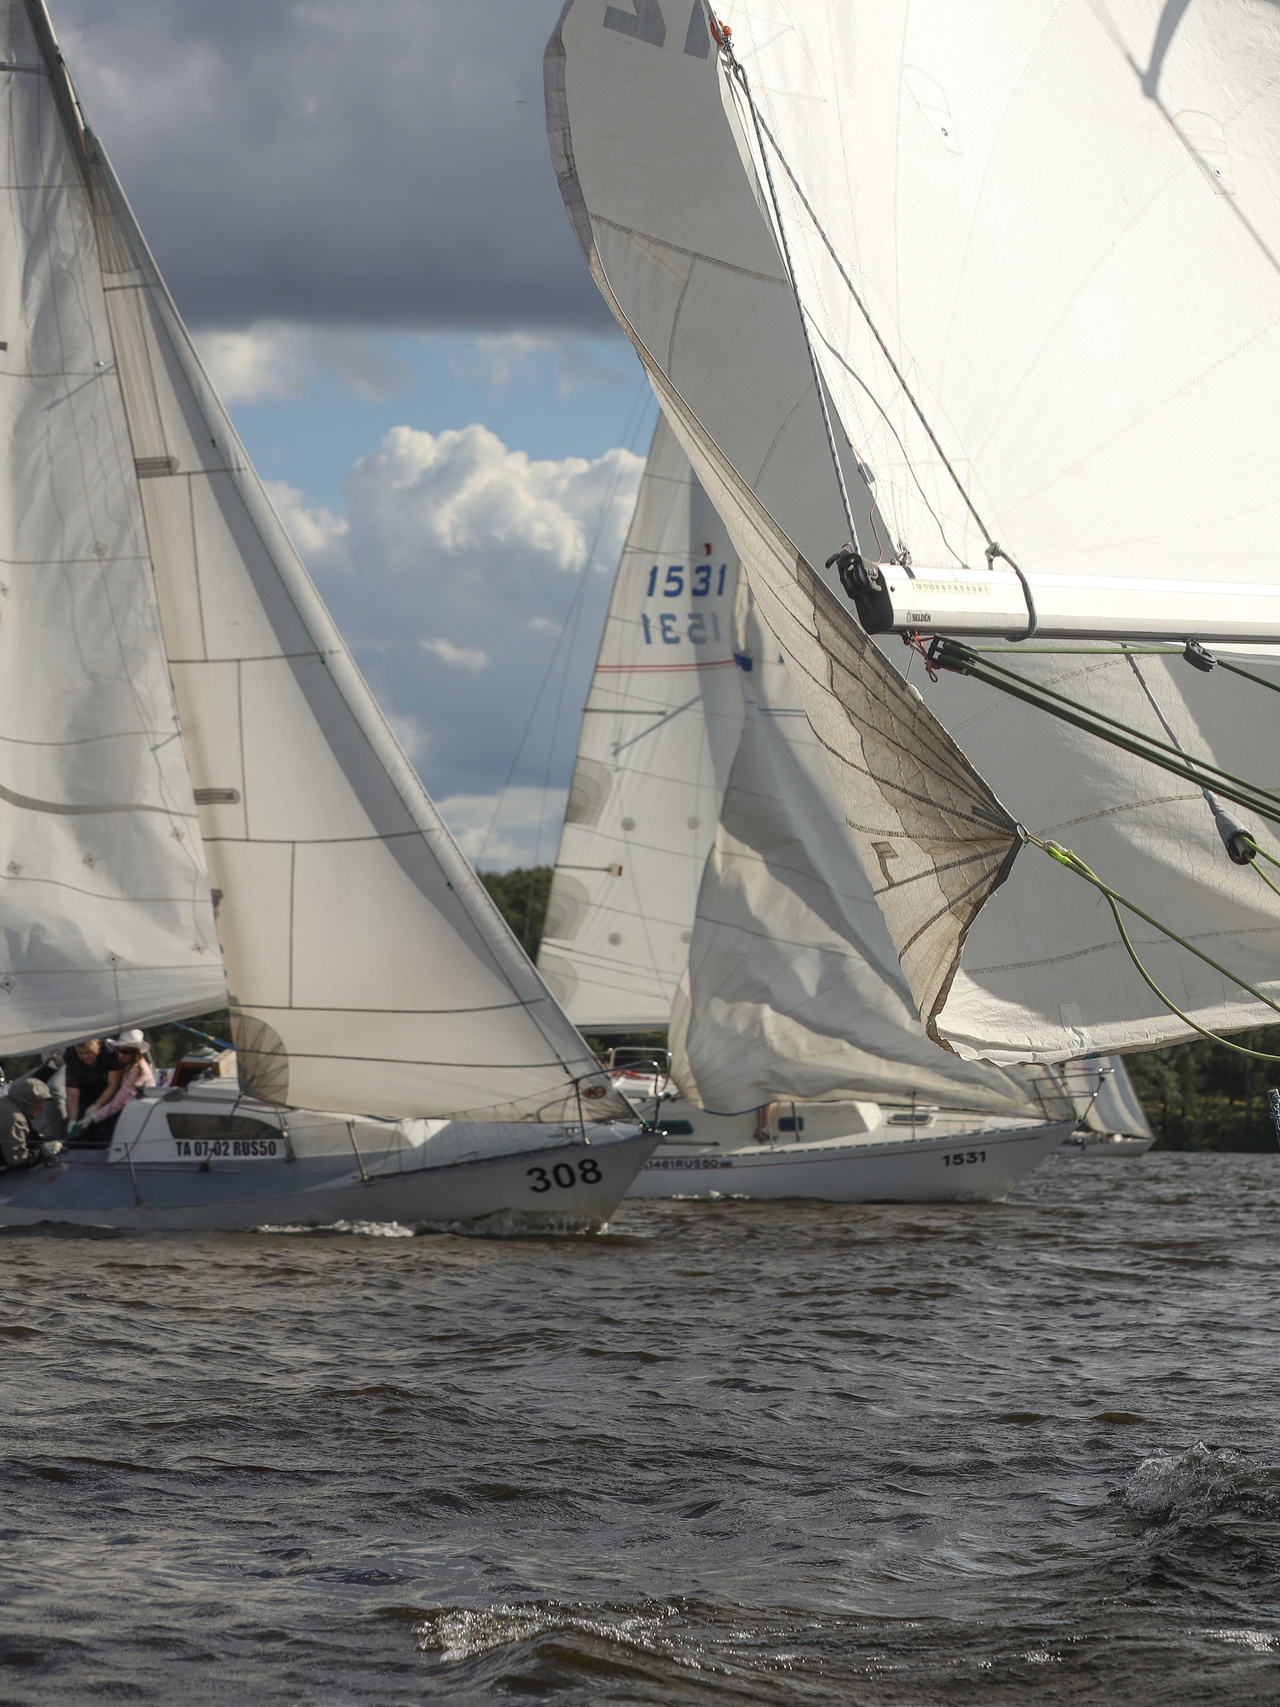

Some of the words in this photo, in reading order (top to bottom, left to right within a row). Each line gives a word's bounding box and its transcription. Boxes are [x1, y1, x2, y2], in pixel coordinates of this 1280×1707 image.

[647, 564, 727, 597] 1531
[912, 612, 931, 622] SELDÉN
[176, 1141, 191, 1156] TA
[194, 1141, 230, 1156] 07-02
[233, 1141, 276, 1156] RUS50
[644, 1159, 719, 1169] 1461RUS50
[943, 1151, 986, 1166] 1531
[526, 1158, 603, 1193] 308
